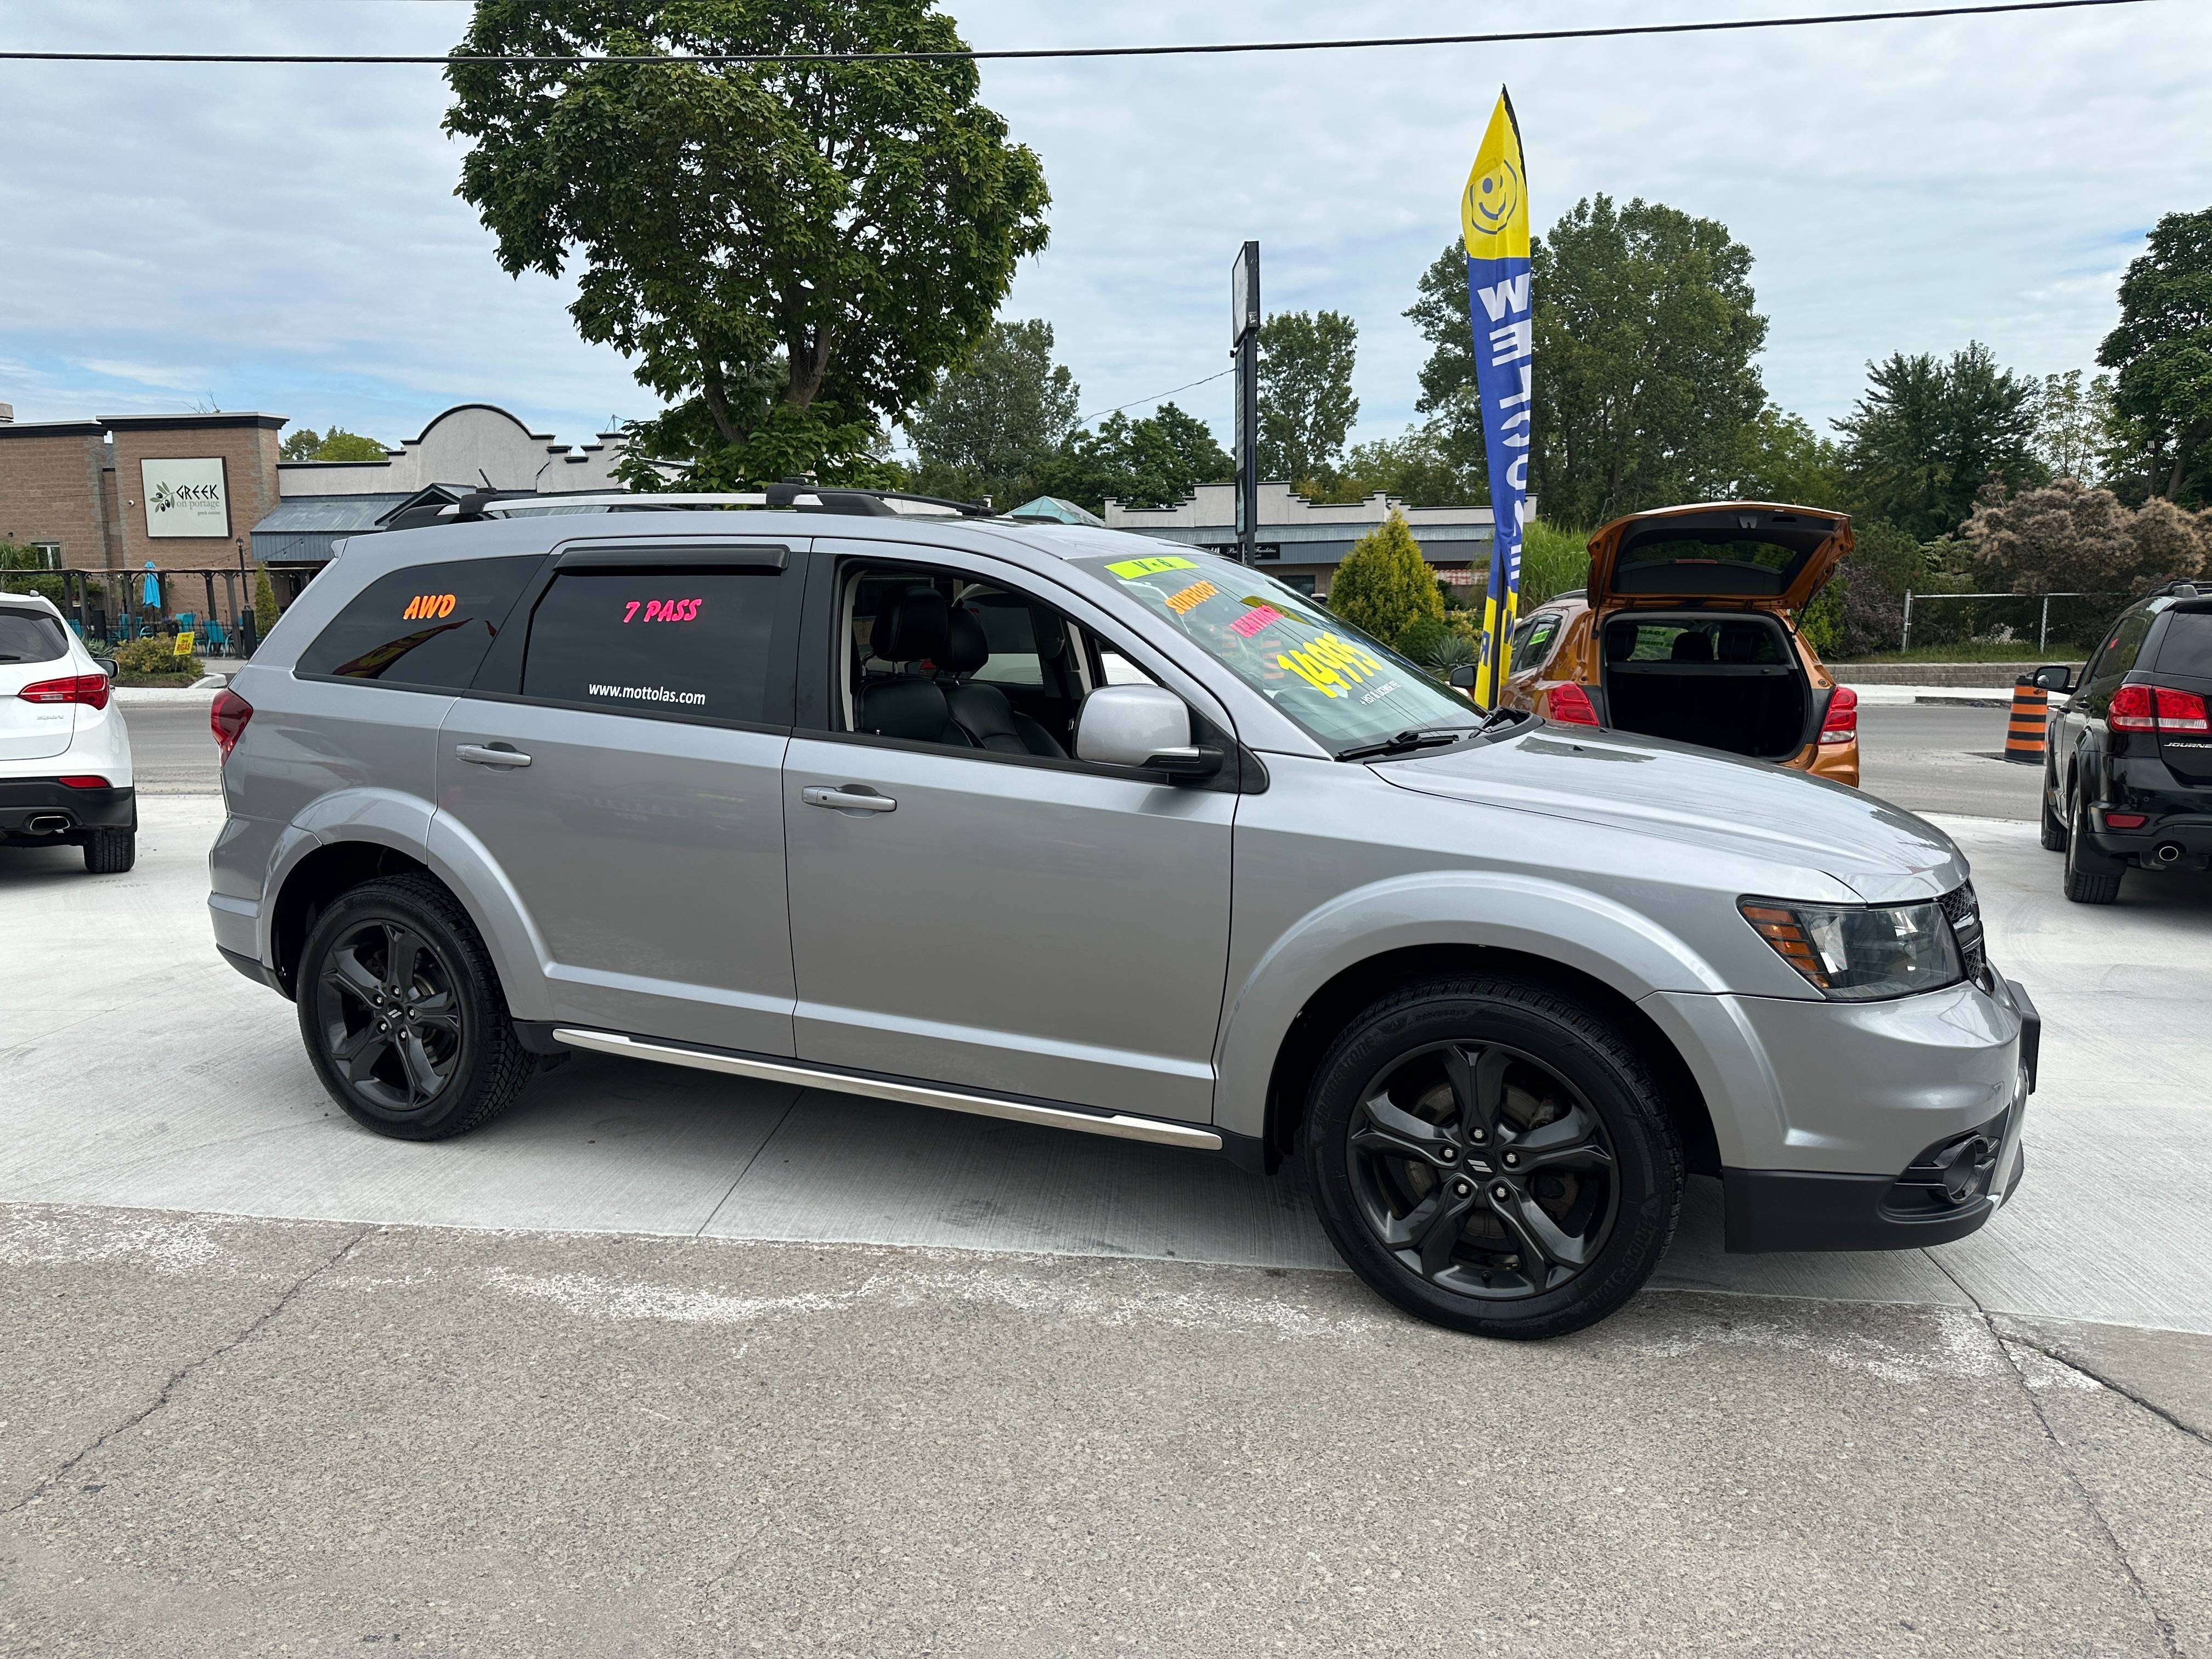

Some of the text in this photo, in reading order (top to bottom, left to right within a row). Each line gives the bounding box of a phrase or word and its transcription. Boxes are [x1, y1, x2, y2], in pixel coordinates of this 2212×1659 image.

[176, 484, 219, 500] GREEK
[189, 499, 220, 510] portage
[403, 594, 456, 620] AWD
[1165, 580, 1220, 615] SUNROOF
[623, 599, 702, 623] 7 PASS
[1229, 604, 1285, 639] LEATHER
[1276, 631, 1383, 698] 14995
[589, 684, 706, 705] www.mottolas.com
